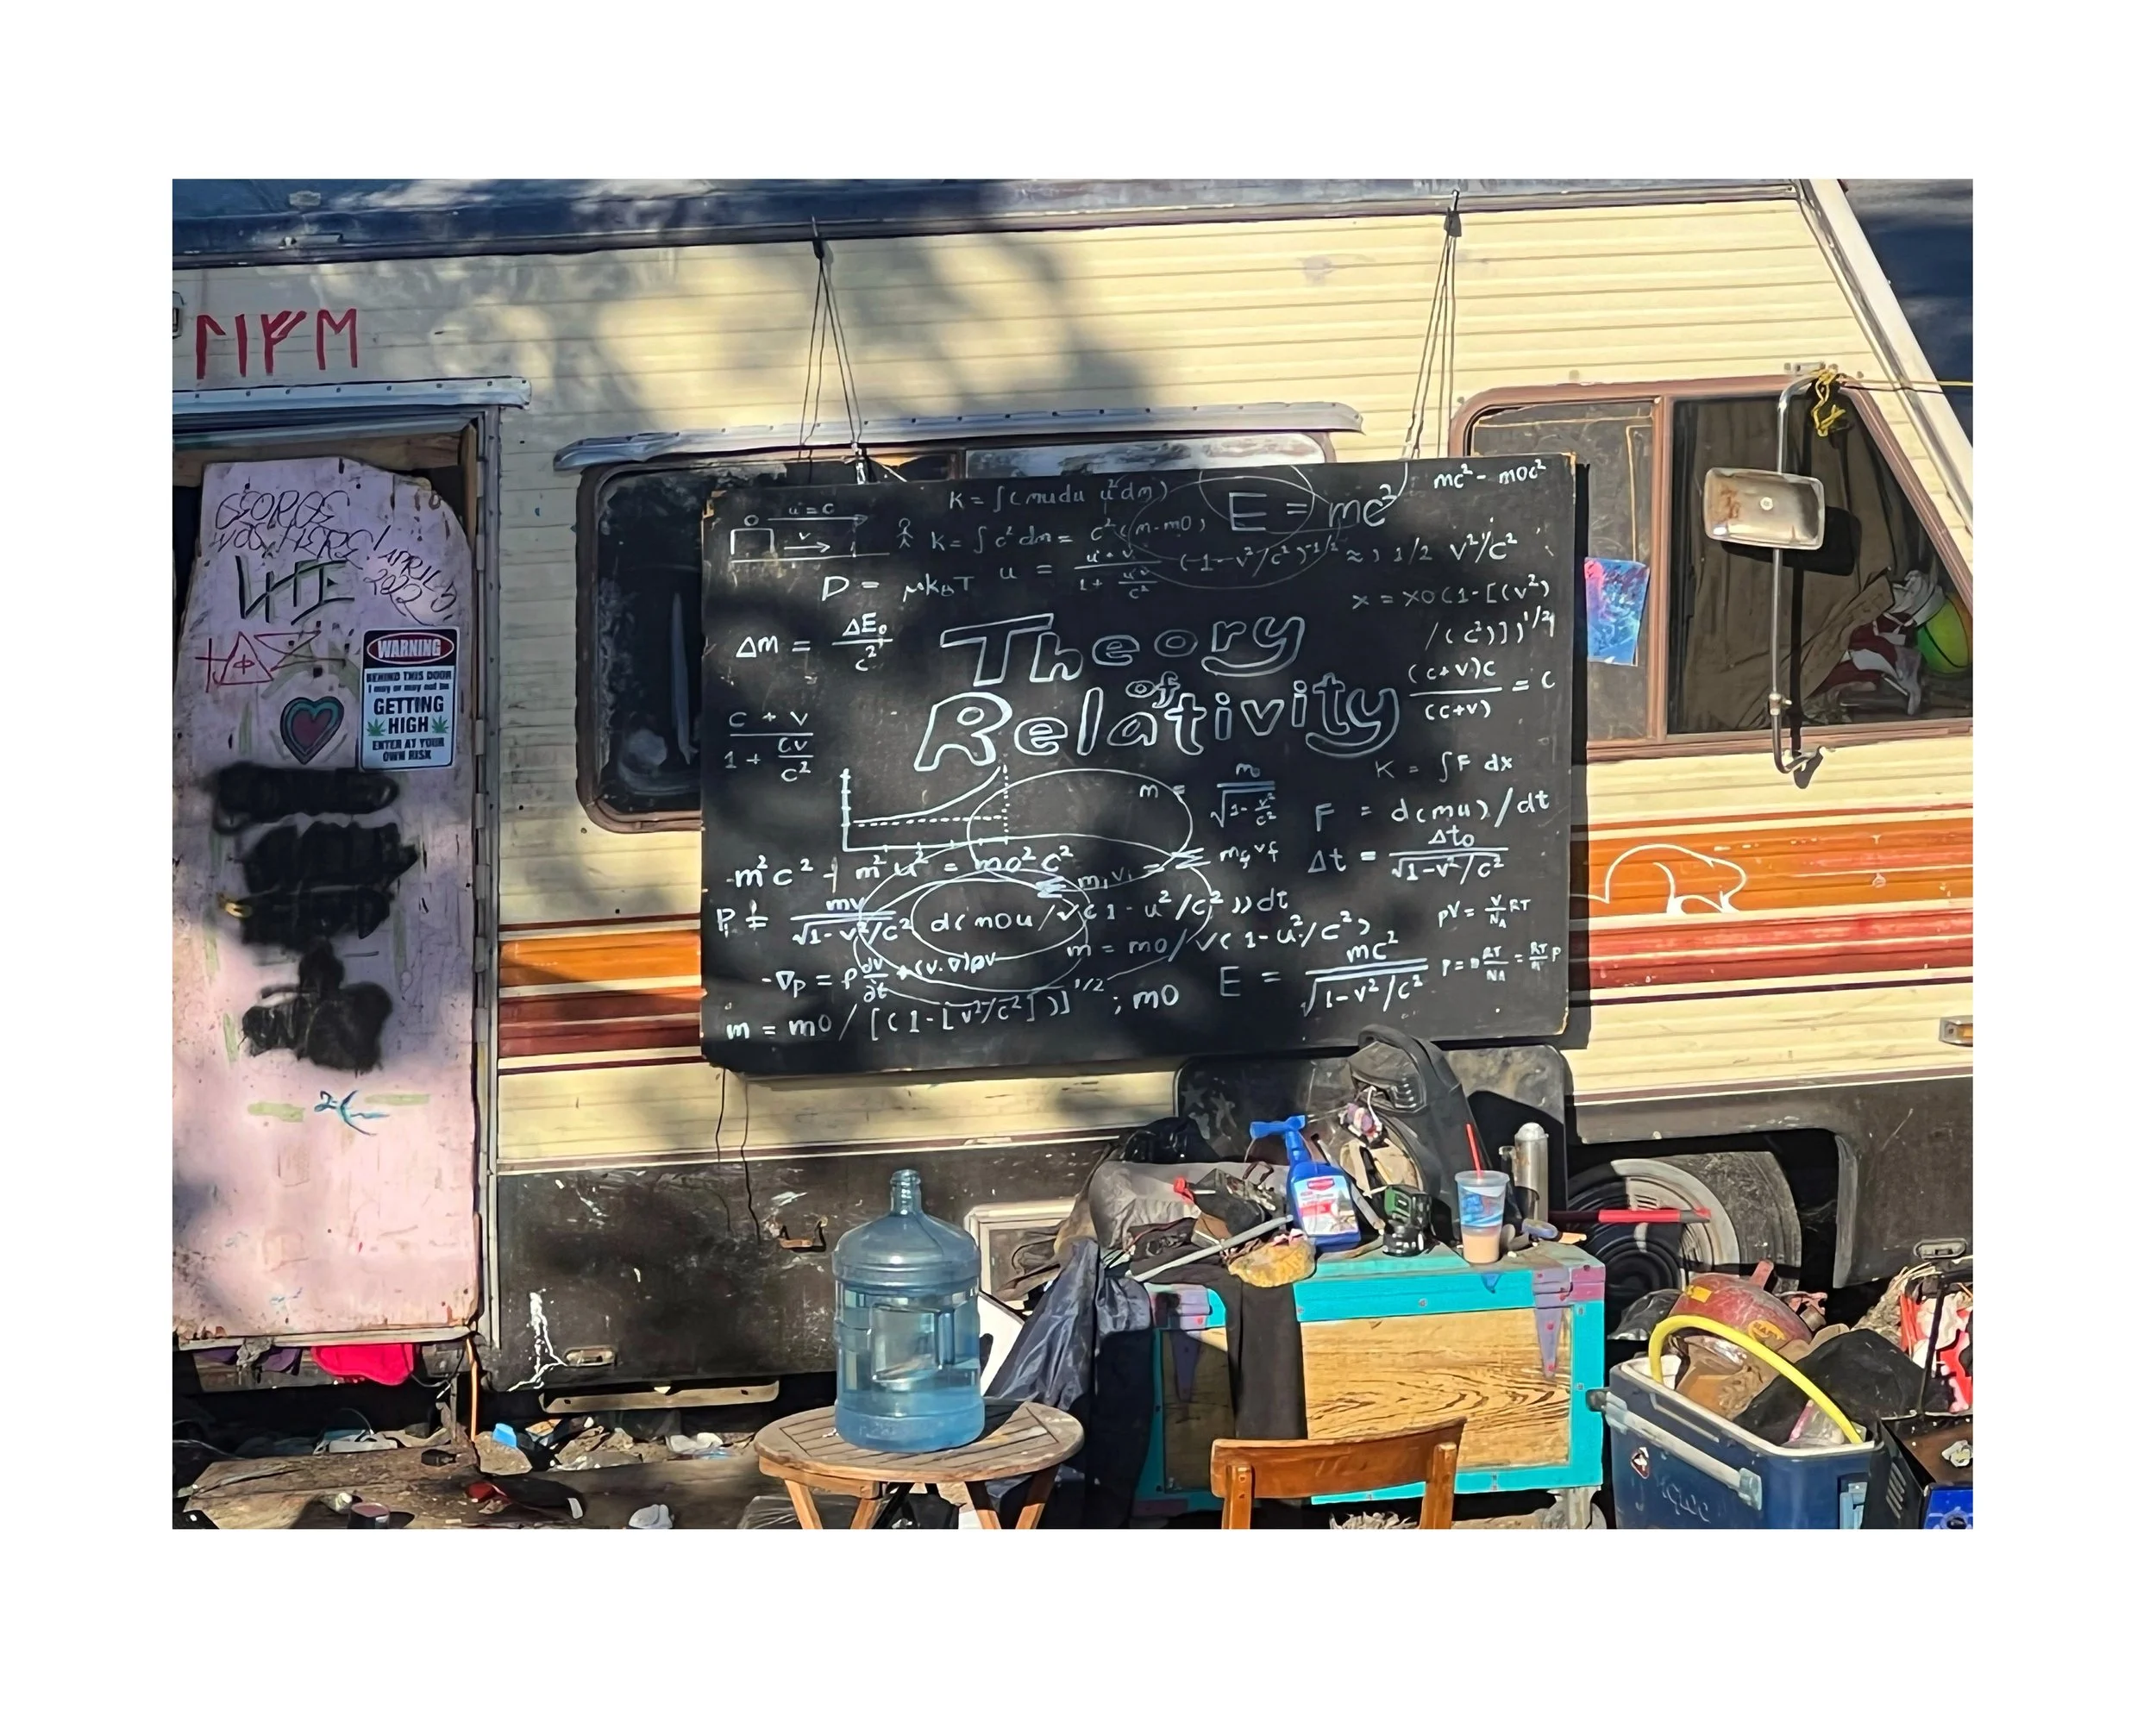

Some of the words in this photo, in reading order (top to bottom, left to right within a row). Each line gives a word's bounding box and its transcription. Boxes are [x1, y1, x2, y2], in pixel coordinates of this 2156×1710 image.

[216, 489, 349, 531] GEORGE
[1228, 492, 1268, 531] E
[1287, 502, 1307, 515] =
[378, 548, 442, 592] APRIL
[378, 639, 442, 658] WARNING
[940, 611, 1306, 687] Theory
[367, 672, 400, 682] BEHIND
[404, 671, 423, 680] THIS
[427, 670, 452, 680] DOOR
[368, 685, 372, 693] I
[1125, 671, 1181, 709] of
[373, 696, 444, 715] GETTING
[388, 717, 429, 734] HIGH
[912, 671, 1401, 773] Relativity
[373, 739, 402, 750] ENTER
[404, 738, 417, 749] AT
[420, 737, 445, 748] YOUR
[383, 750, 405, 761] OWN
[408, 749, 431, 760] RISK
[1219, 965, 1241, 997] E
[726, 1021, 749, 1040] m
